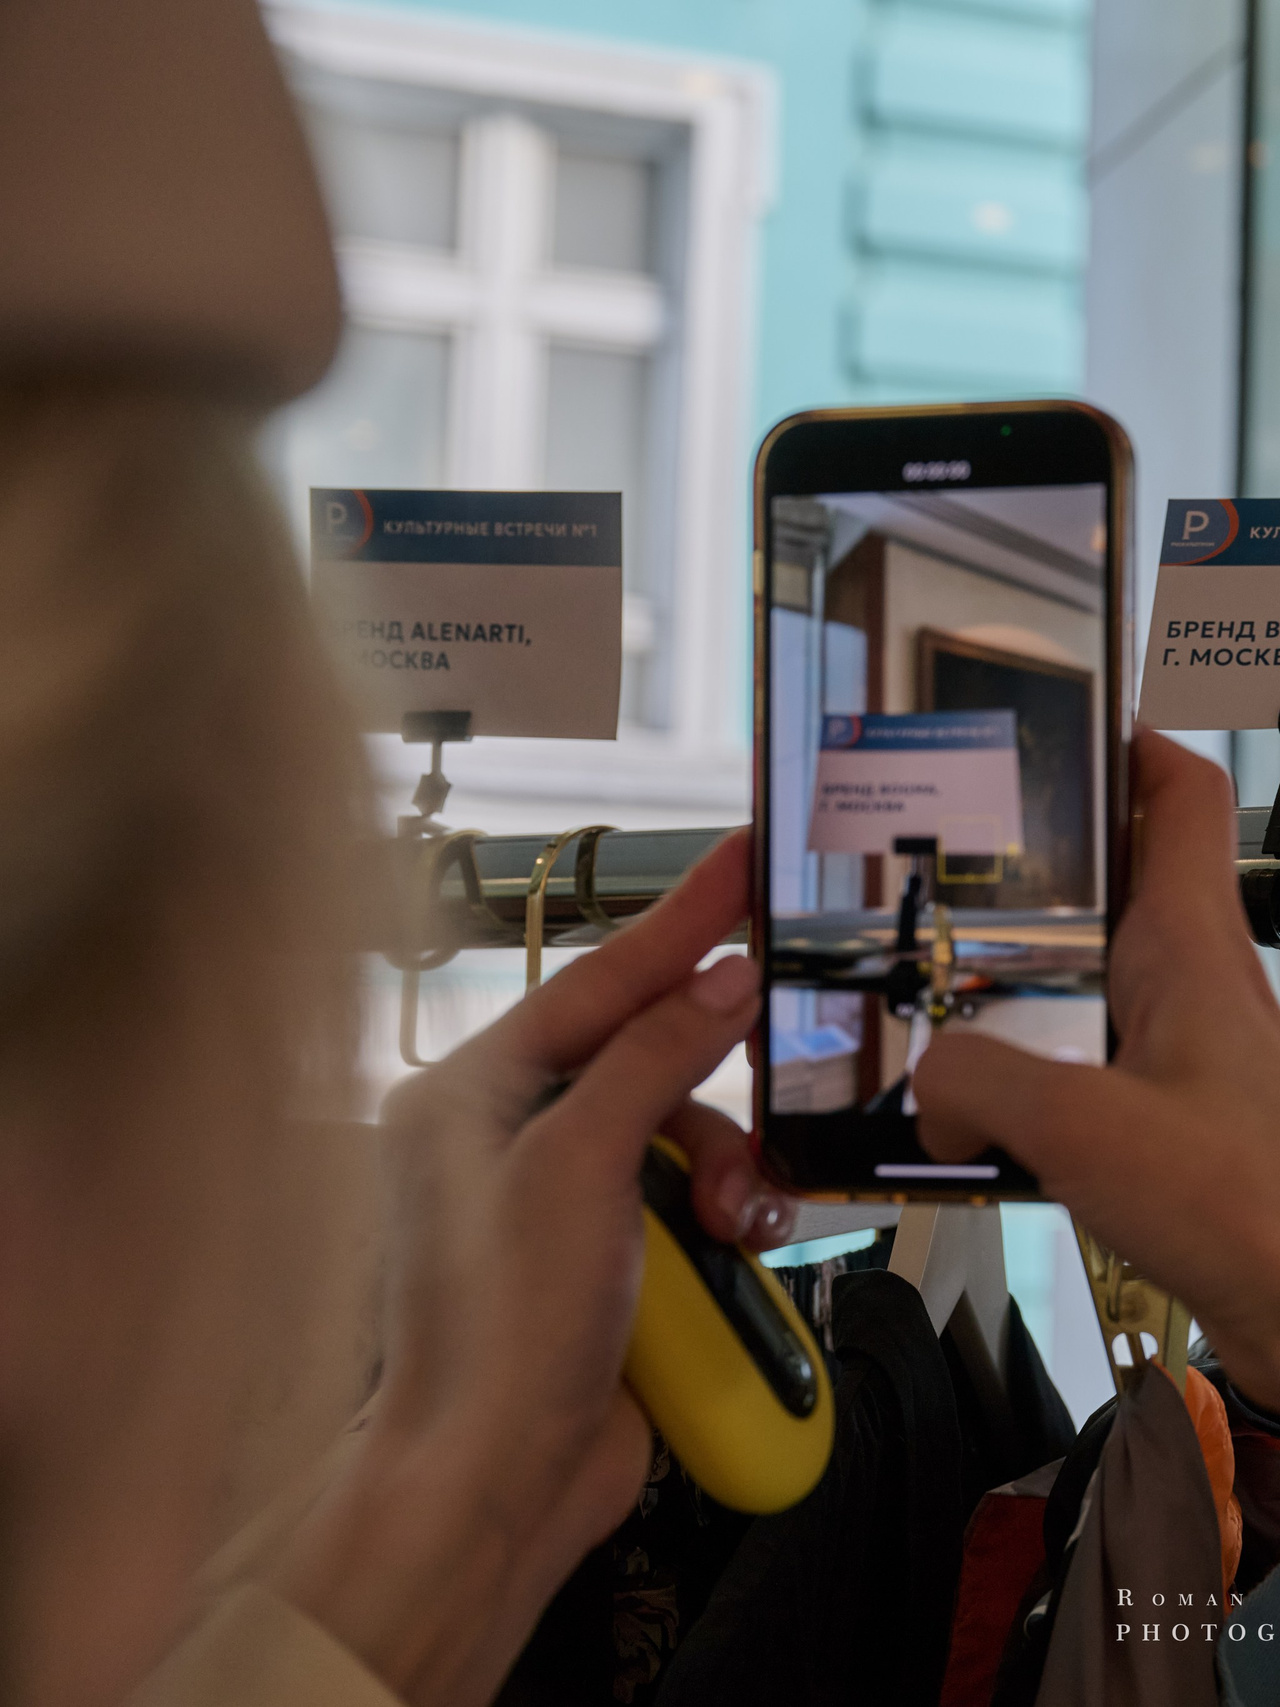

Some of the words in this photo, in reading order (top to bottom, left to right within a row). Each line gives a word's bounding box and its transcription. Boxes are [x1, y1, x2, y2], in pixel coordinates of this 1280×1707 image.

[383, 519, 490, 537] КУЛЬТУРНЫЕ
[494, 520, 566, 538] ВСТРЕЧИ
[411, 622, 532, 646] ALENARTI,
[1166, 619, 1256, 643] БРЕНД
[1162, 648, 1180, 667] Г.
